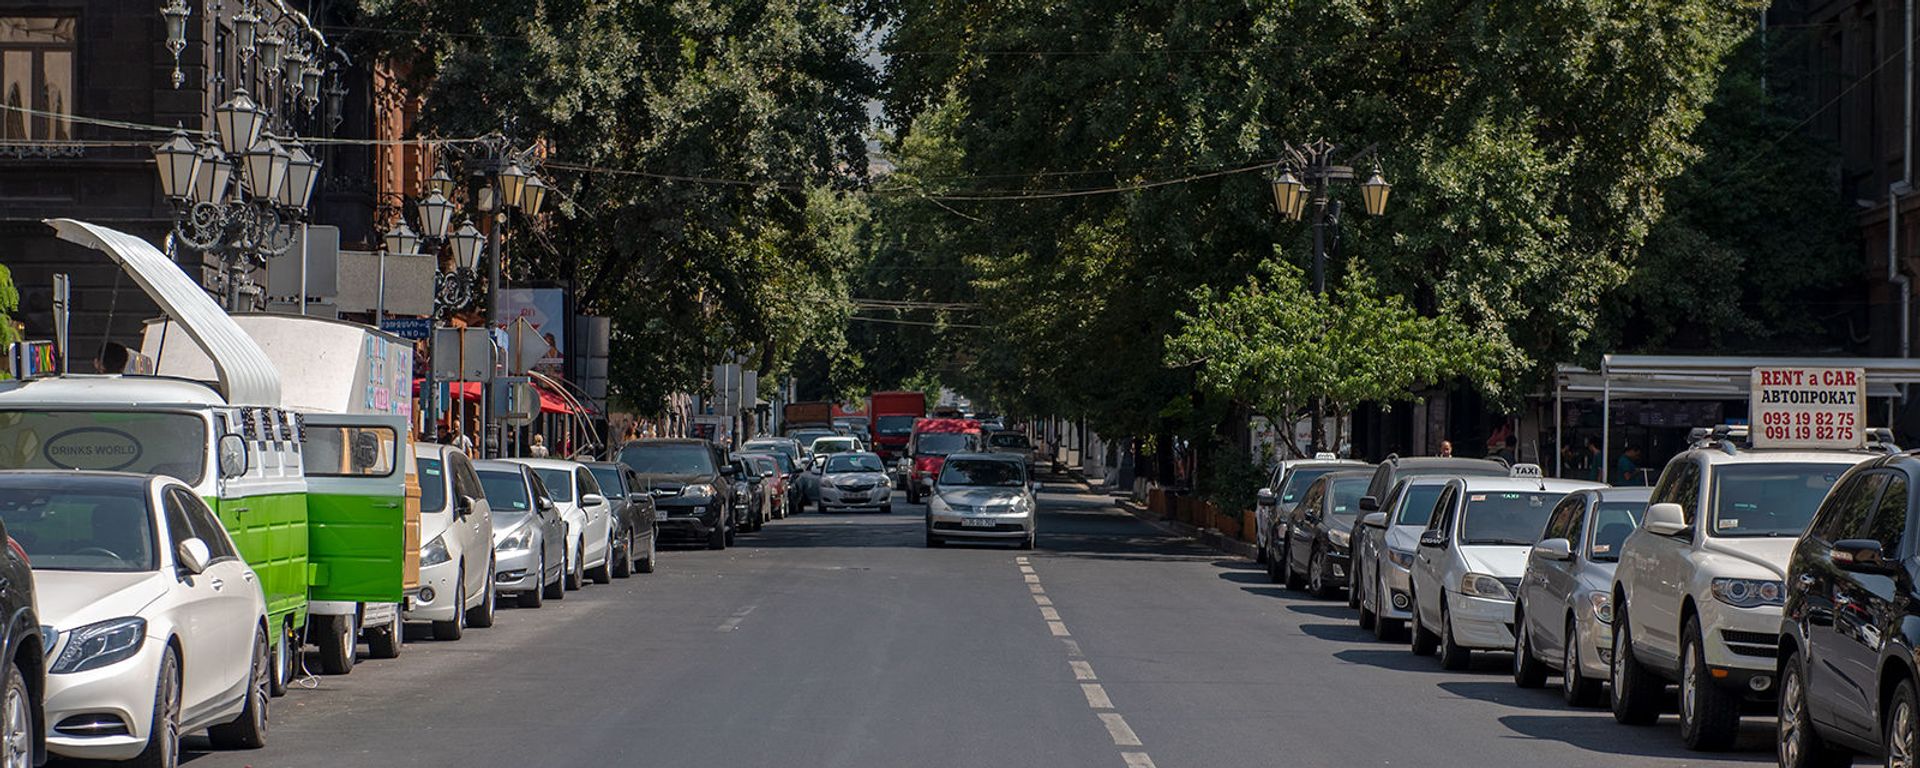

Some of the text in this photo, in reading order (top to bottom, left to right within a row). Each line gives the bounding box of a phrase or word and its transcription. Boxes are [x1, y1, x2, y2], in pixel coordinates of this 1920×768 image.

[1760, 370, 1857, 386] RENT a CAR
[1761, 390, 1857, 405] АВТОПРОКАТ
[1763, 412, 1854, 426] 093 19 82 75
[1765, 426, 1853, 440] 091 19 82 75
[51, 444, 136, 456] DRINKS WORLD
[1514, 466, 1539, 476] TAXI
